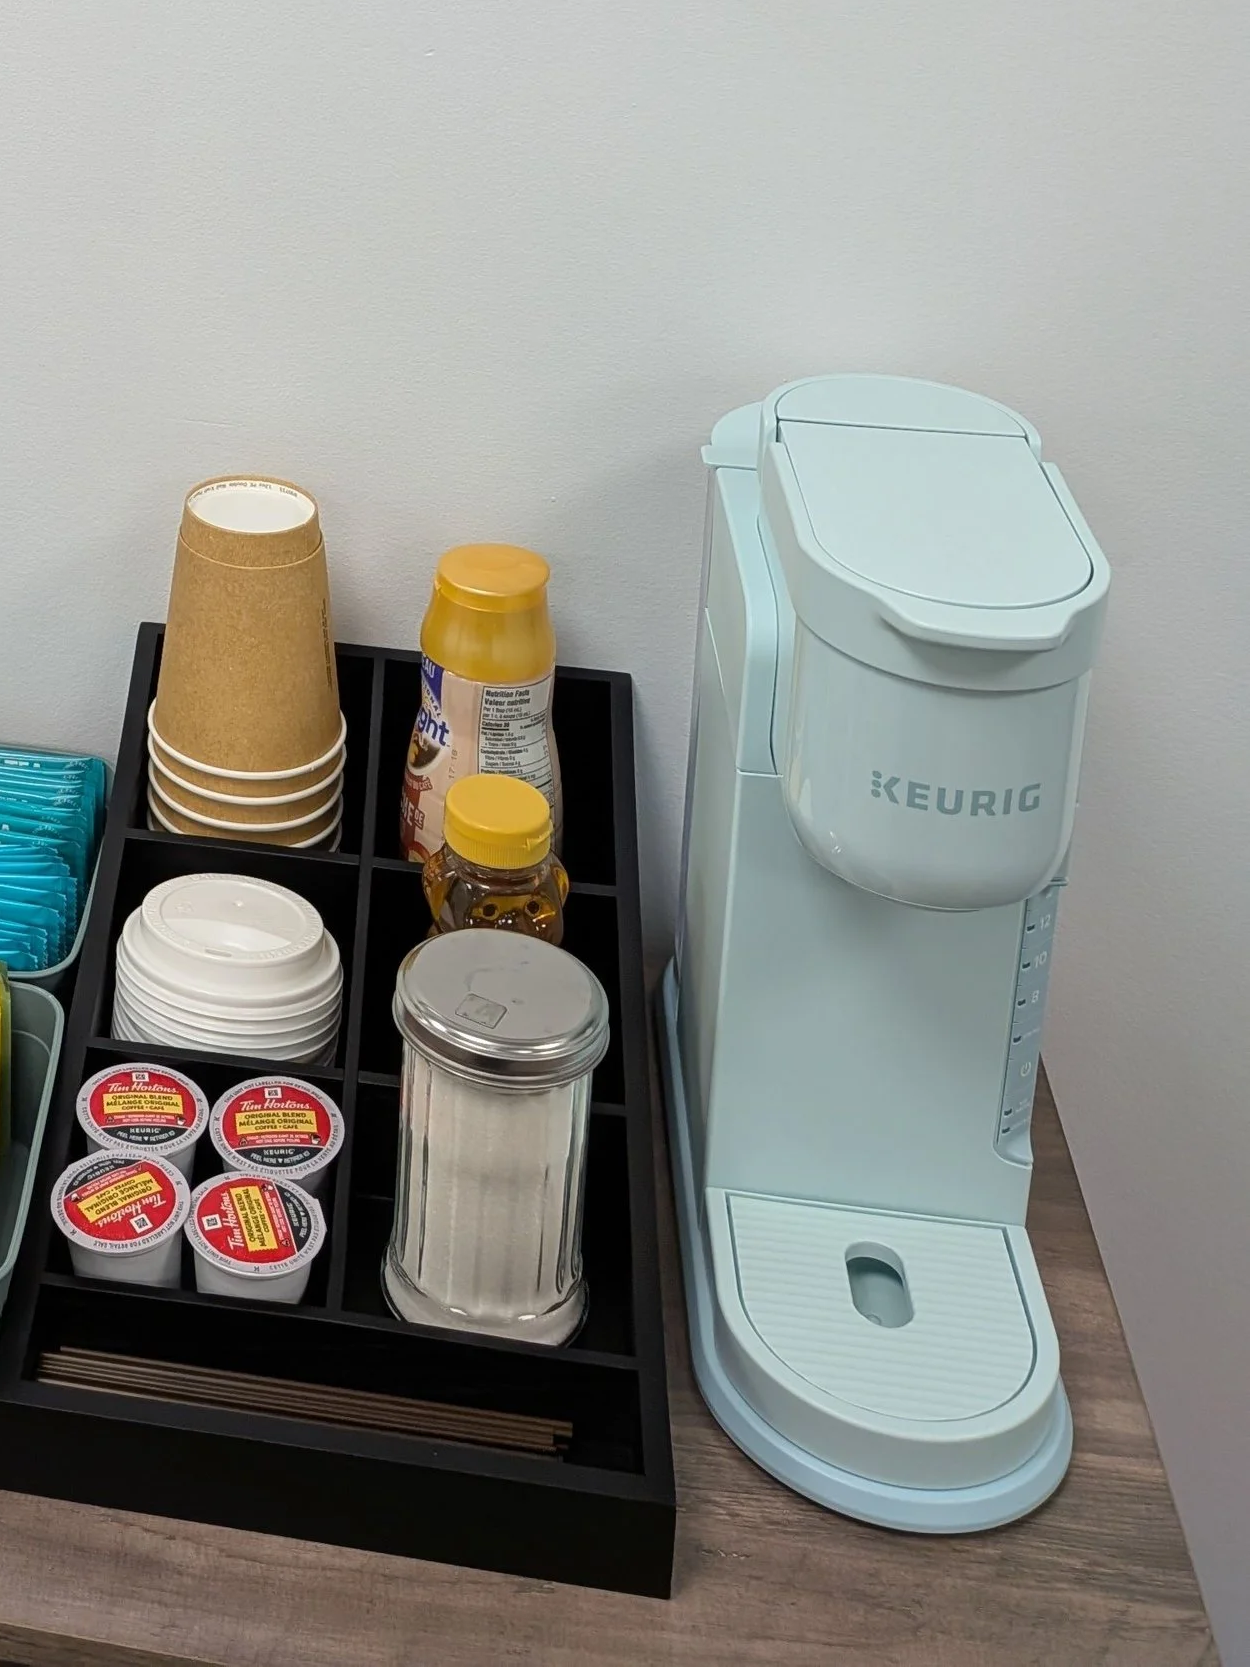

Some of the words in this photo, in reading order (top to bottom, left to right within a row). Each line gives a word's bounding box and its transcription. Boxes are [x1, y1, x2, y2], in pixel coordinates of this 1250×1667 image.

[870, 769, 1042, 817] KEURIG
[239, 1099, 262, 1111] Tim
[244, 1112, 282, 1120] ORIGINAL
[238, 1118, 276, 1127] MÉLANGE
[277, 1118, 314, 1126] ORIGINAL
